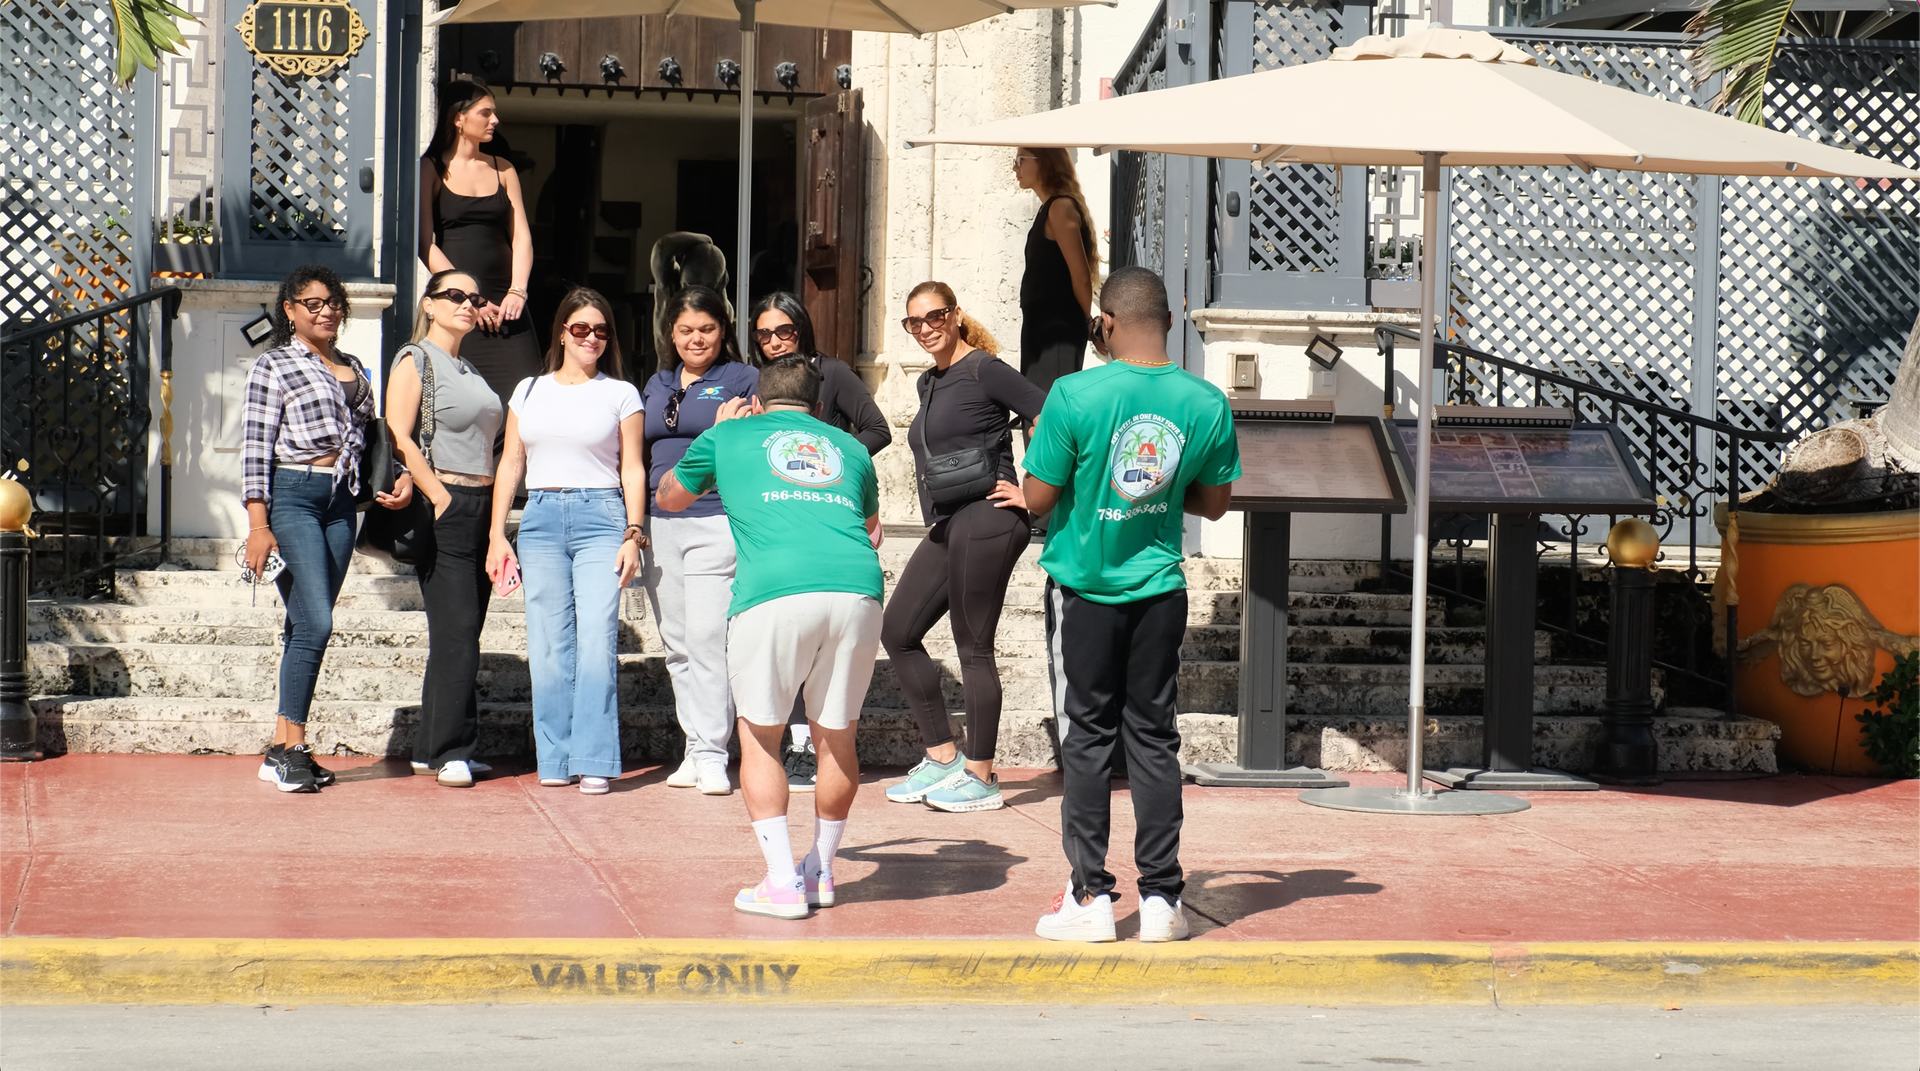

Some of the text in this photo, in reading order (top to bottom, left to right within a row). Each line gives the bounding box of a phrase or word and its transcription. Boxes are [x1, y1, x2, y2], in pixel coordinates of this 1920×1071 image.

[273, 7, 332, 52] 1116
[1111, 432, 1120, 445] KEY
[1152, 413, 1166, 423] DAY
[1165, 419, 1181, 435] YOUR
[1178, 432, 1187, 447] WA
[761, 490, 856, 511] 786-858-3458
[530, 963, 800, 996] VALET ONLY
